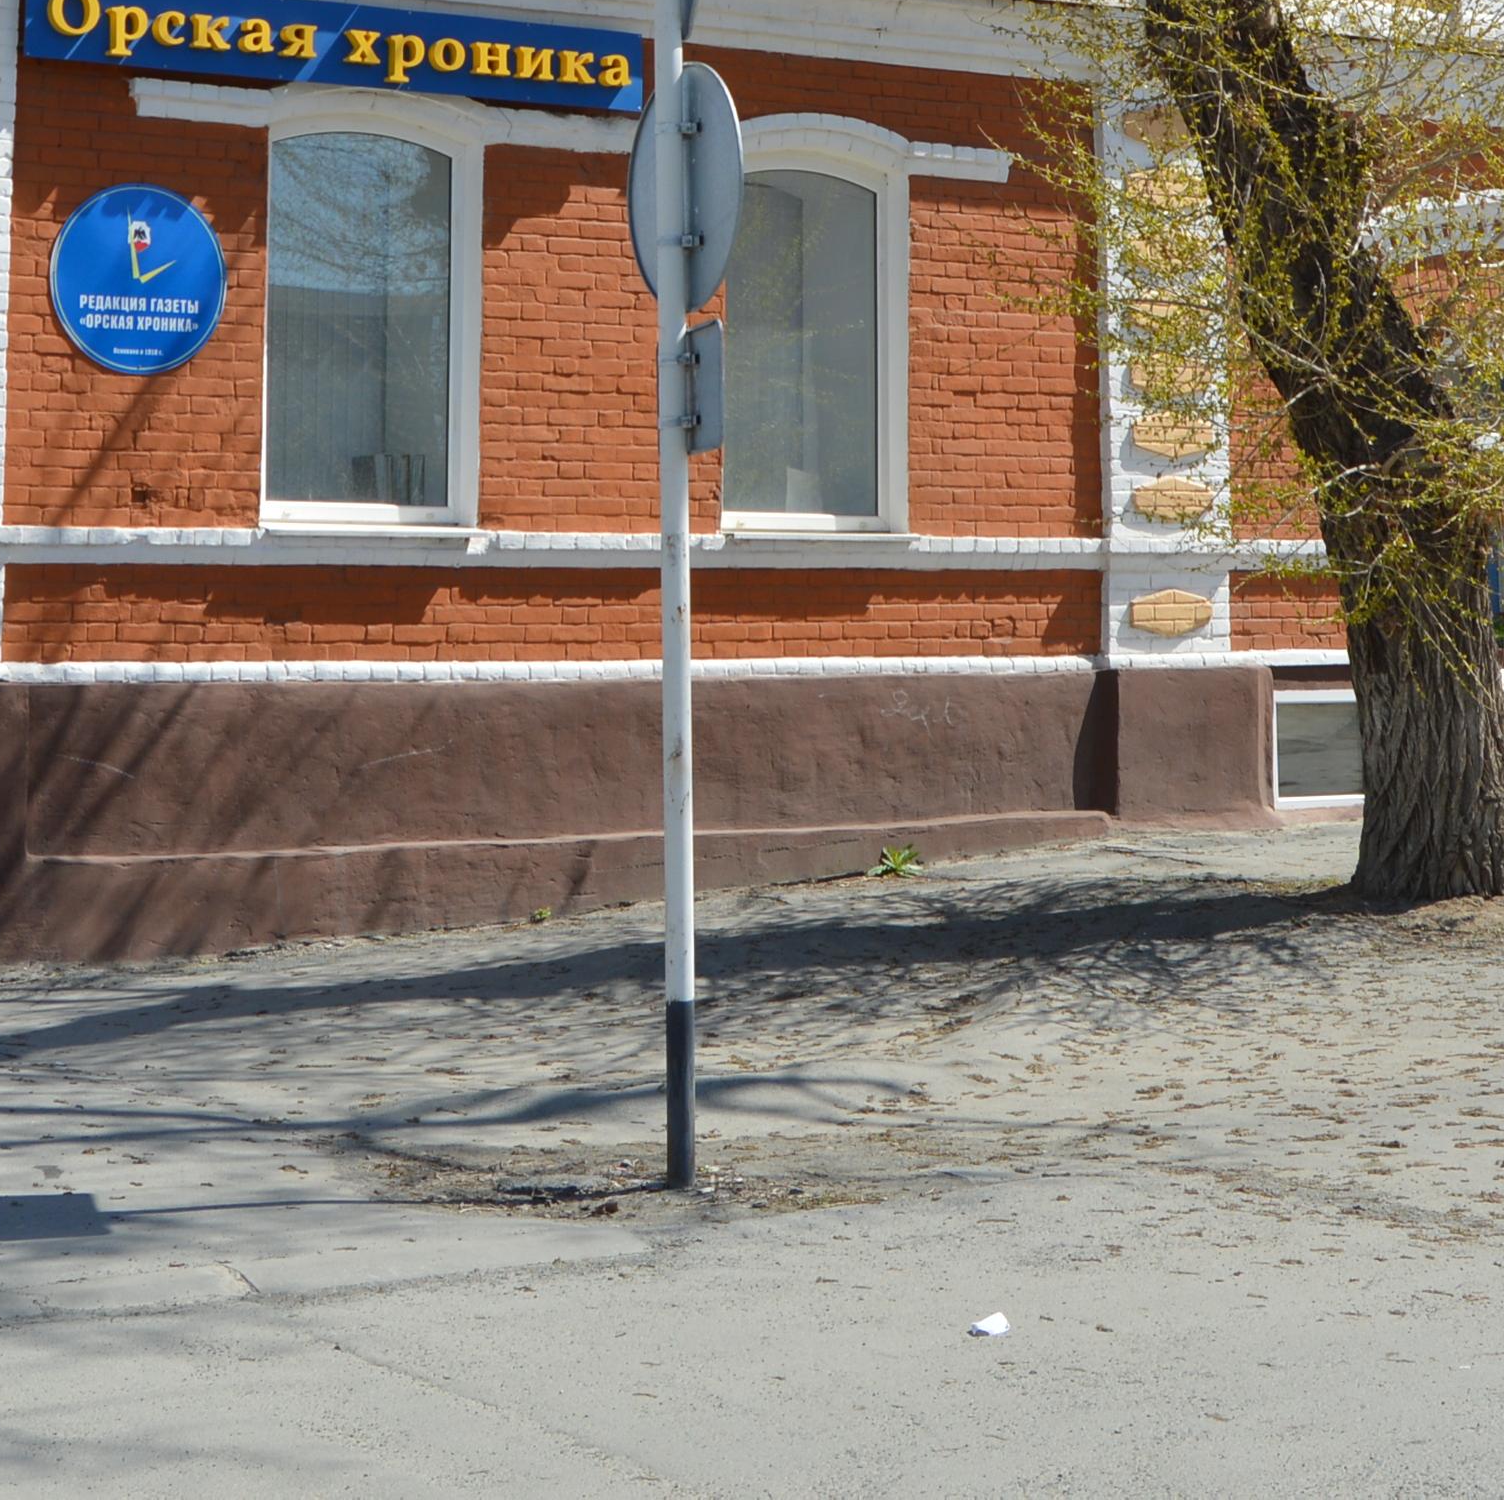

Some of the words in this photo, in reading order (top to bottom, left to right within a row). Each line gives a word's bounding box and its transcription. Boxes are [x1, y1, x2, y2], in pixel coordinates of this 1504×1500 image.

[343, 29, 632, 86] хроника
[79, 294, 146, 312] РЕДАКЦИЯ
[150, 298, 199, 314] ГАЗЕТЫ
[79, 313, 133, 330] «ОРСКАЯ
[137, 316, 199, 333] ХРОНИКА»
